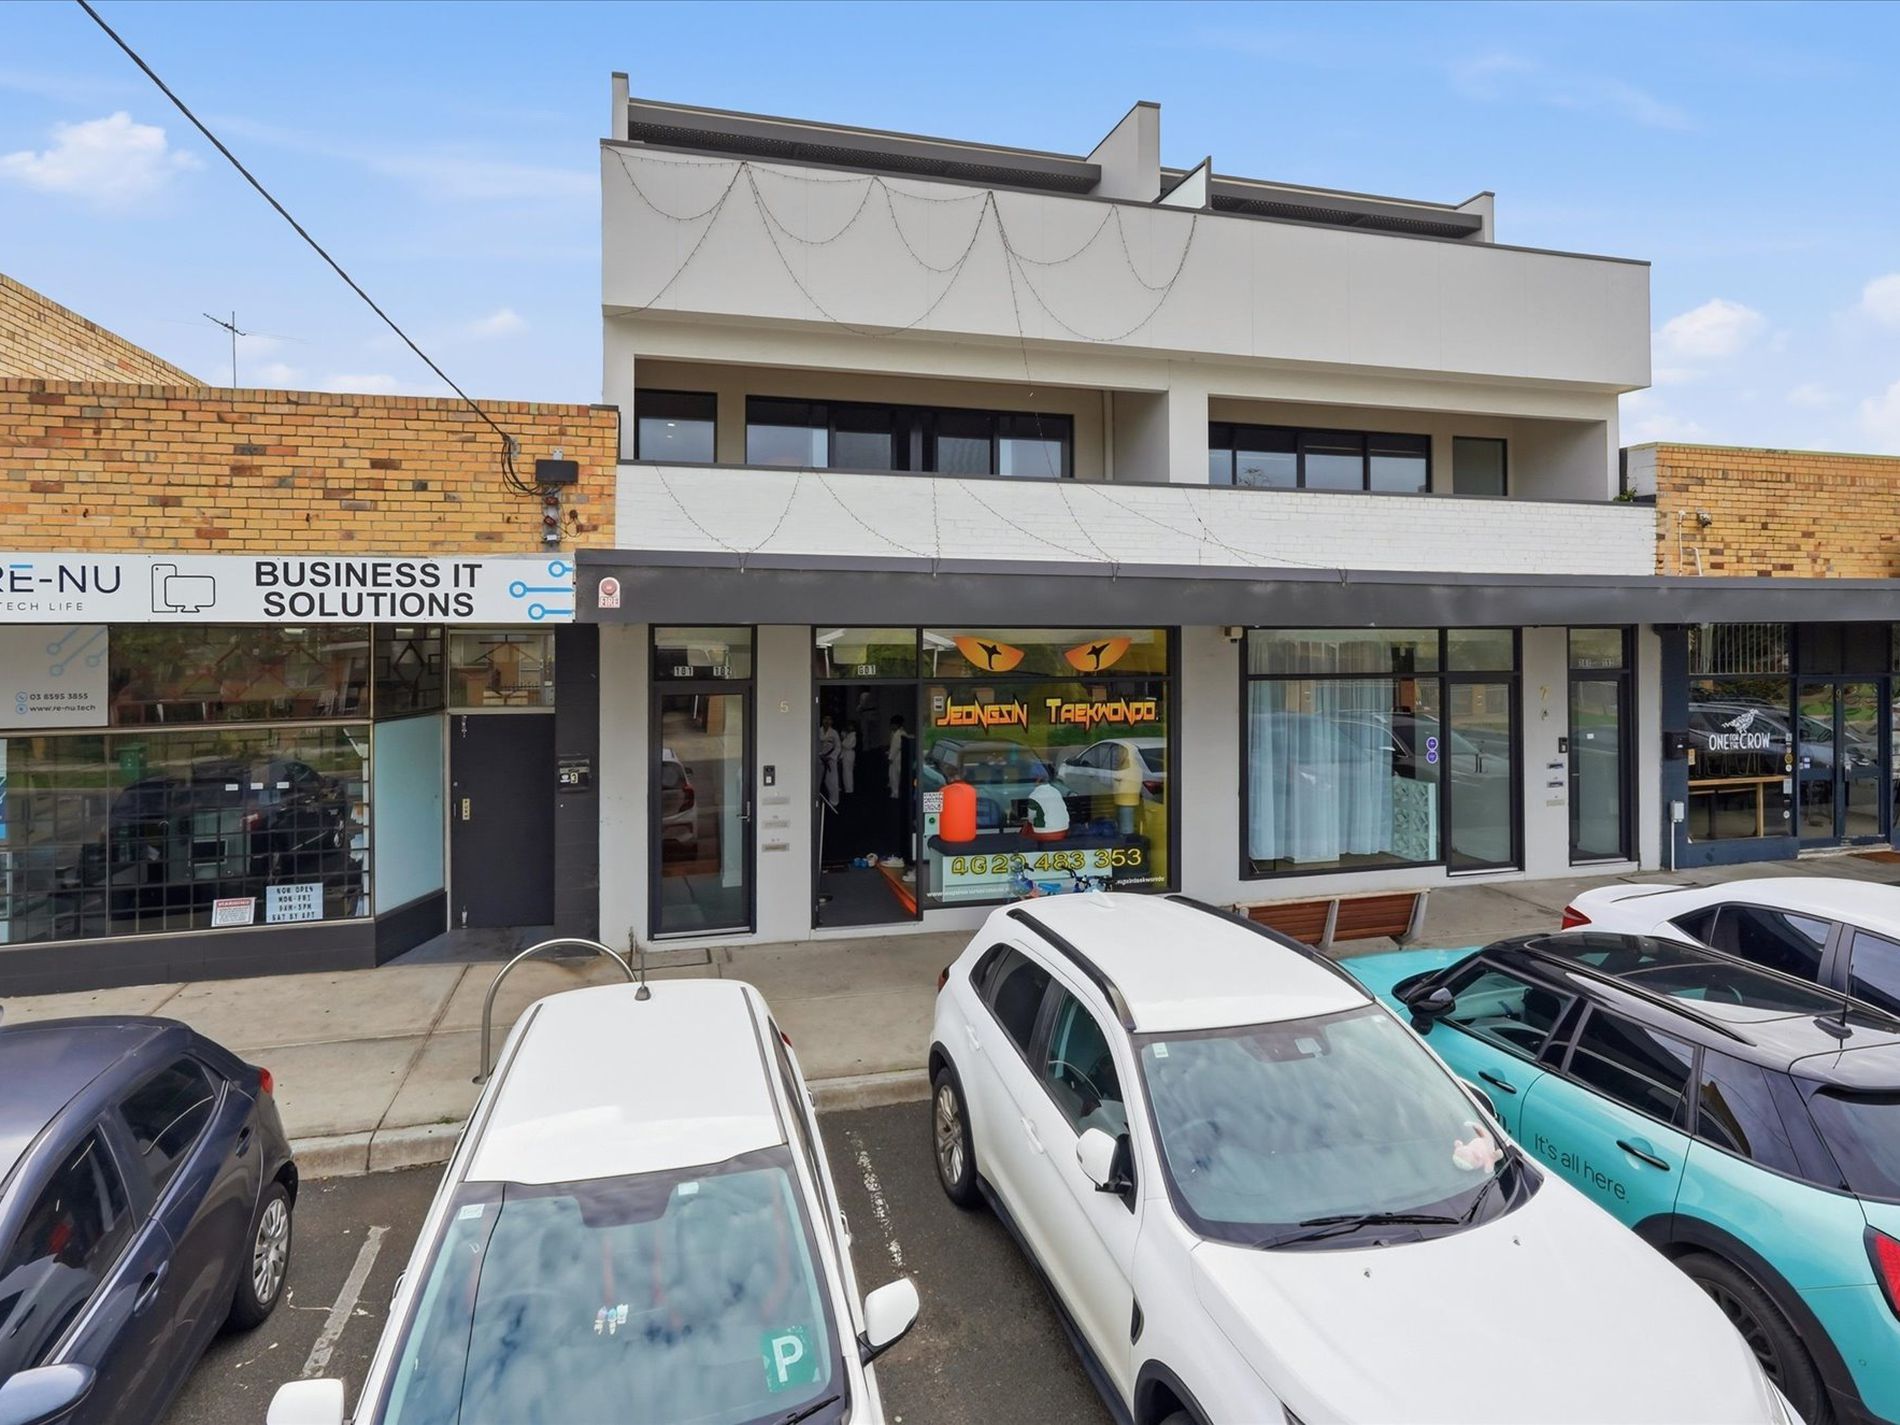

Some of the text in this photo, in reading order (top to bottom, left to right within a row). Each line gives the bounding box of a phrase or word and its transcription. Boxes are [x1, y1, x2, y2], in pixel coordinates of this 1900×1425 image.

[0, 564, 121, 594] E-NU
[255, 561, 483, 588] BUSINESS IT
[50, 602, 84, 611] LIFE
[263, 591, 474, 617] SOLUTIONS
[29, 693, 41, 701] 03
[780, 701, 789, 713] 5
[1045, 697, 1157, 731] TAEKWONDO
[1708, 734, 1730, 751] ONE
[1739, 732, 1771, 750] CROW
[1034, 850, 1085, 872] 483
[1095, 848, 1142, 869] 353
[296, 885, 314, 893] OPEN
[1534, 1132, 1557, 1160] It's
[1561, 1152, 1579, 1174] all
[771, 1335, 804, 1383] P
